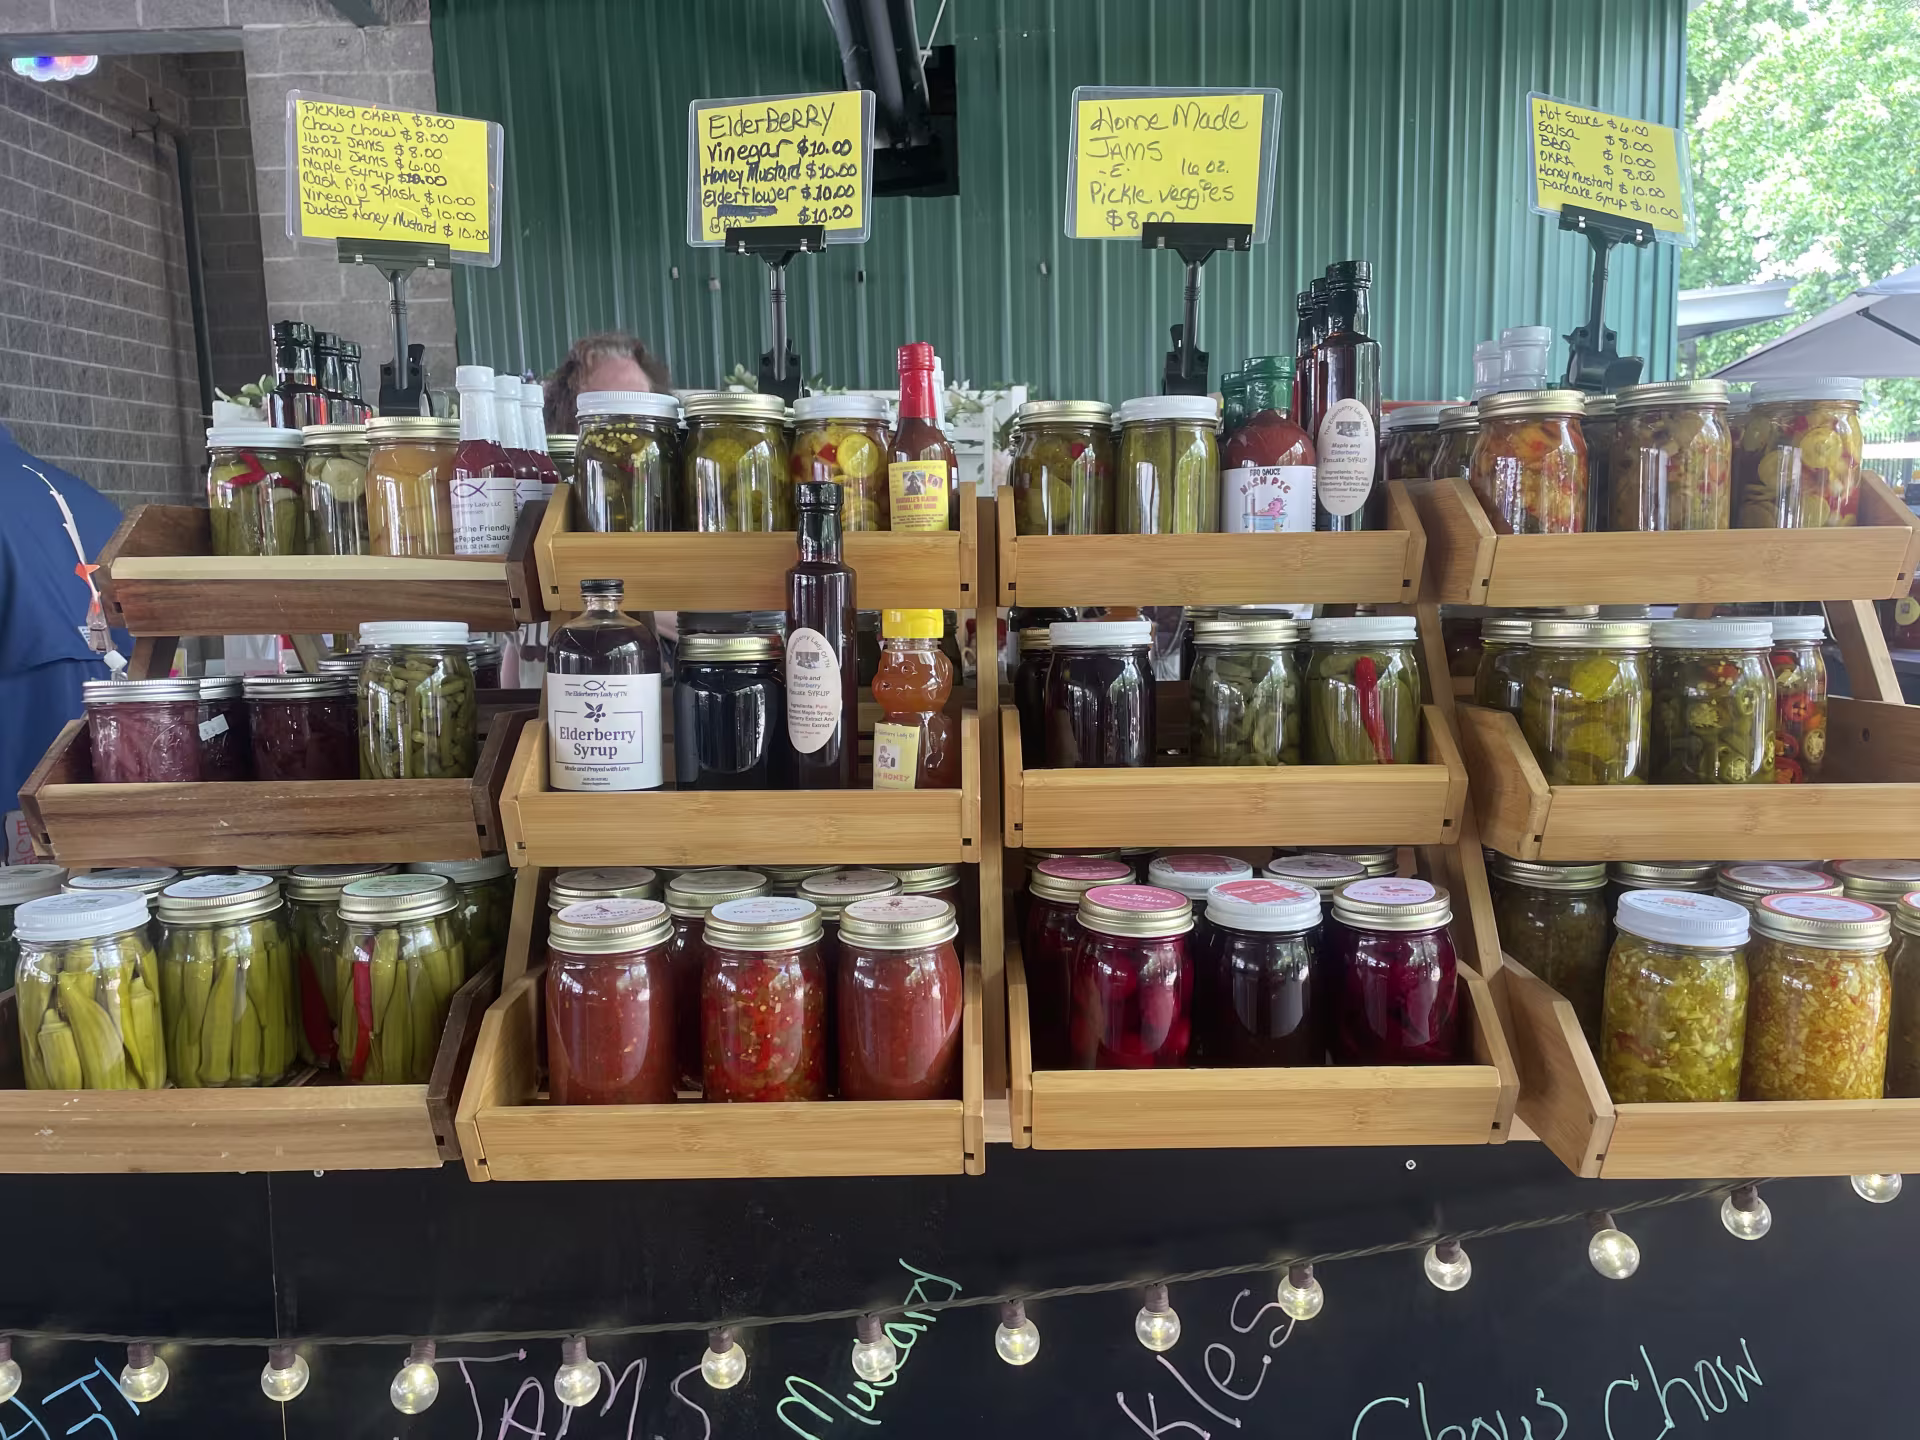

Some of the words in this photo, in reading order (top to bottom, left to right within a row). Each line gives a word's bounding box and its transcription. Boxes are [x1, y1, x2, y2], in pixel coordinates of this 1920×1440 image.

[1090, 106, 1168, 133] Home
[1173, 102, 1248, 131] Made
[1540, 104, 1561, 120] Hot
[302, 117, 344, 132] Chow
[351, 124, 396, 138] Chow
[347, 137, 384, 151] JAMS
[707, 139, 794, 163] Vinegar
[797, 135, 852, 157] $10.00
[1539, 134, 1571, 152] BBQ
[303, 158, 346, 173] Maple
[1540, 151, 1575, 167] OKRA
[303, 172, 340, 189] Nash
[703, 165, 743, 189] Honey
[746, 157, 801, 184] Mustard
[806, 160, 857, 180] $10.00
[1540, 163, 1570, 184] Honey
[303, 187, 370, 208] Vinegar
[801, 184, 855, 202] $10.00
[353, 210, 389, 231] Honey
[393, 212, 436, 234] Mustard
[798, 204, 853, 224] $10.00
[1262, 468, 1281, 476] SAUCE
[1240, 476, 1267, 495] NASH
[811, 637, 822, 651] Lady
[560, 726, 635, 743] Elderberry
[573, 743, 617, 759] Syrup
[883, 773, 910, 781] HONEY
[1605, 1337, 1763, 1440] Chow
